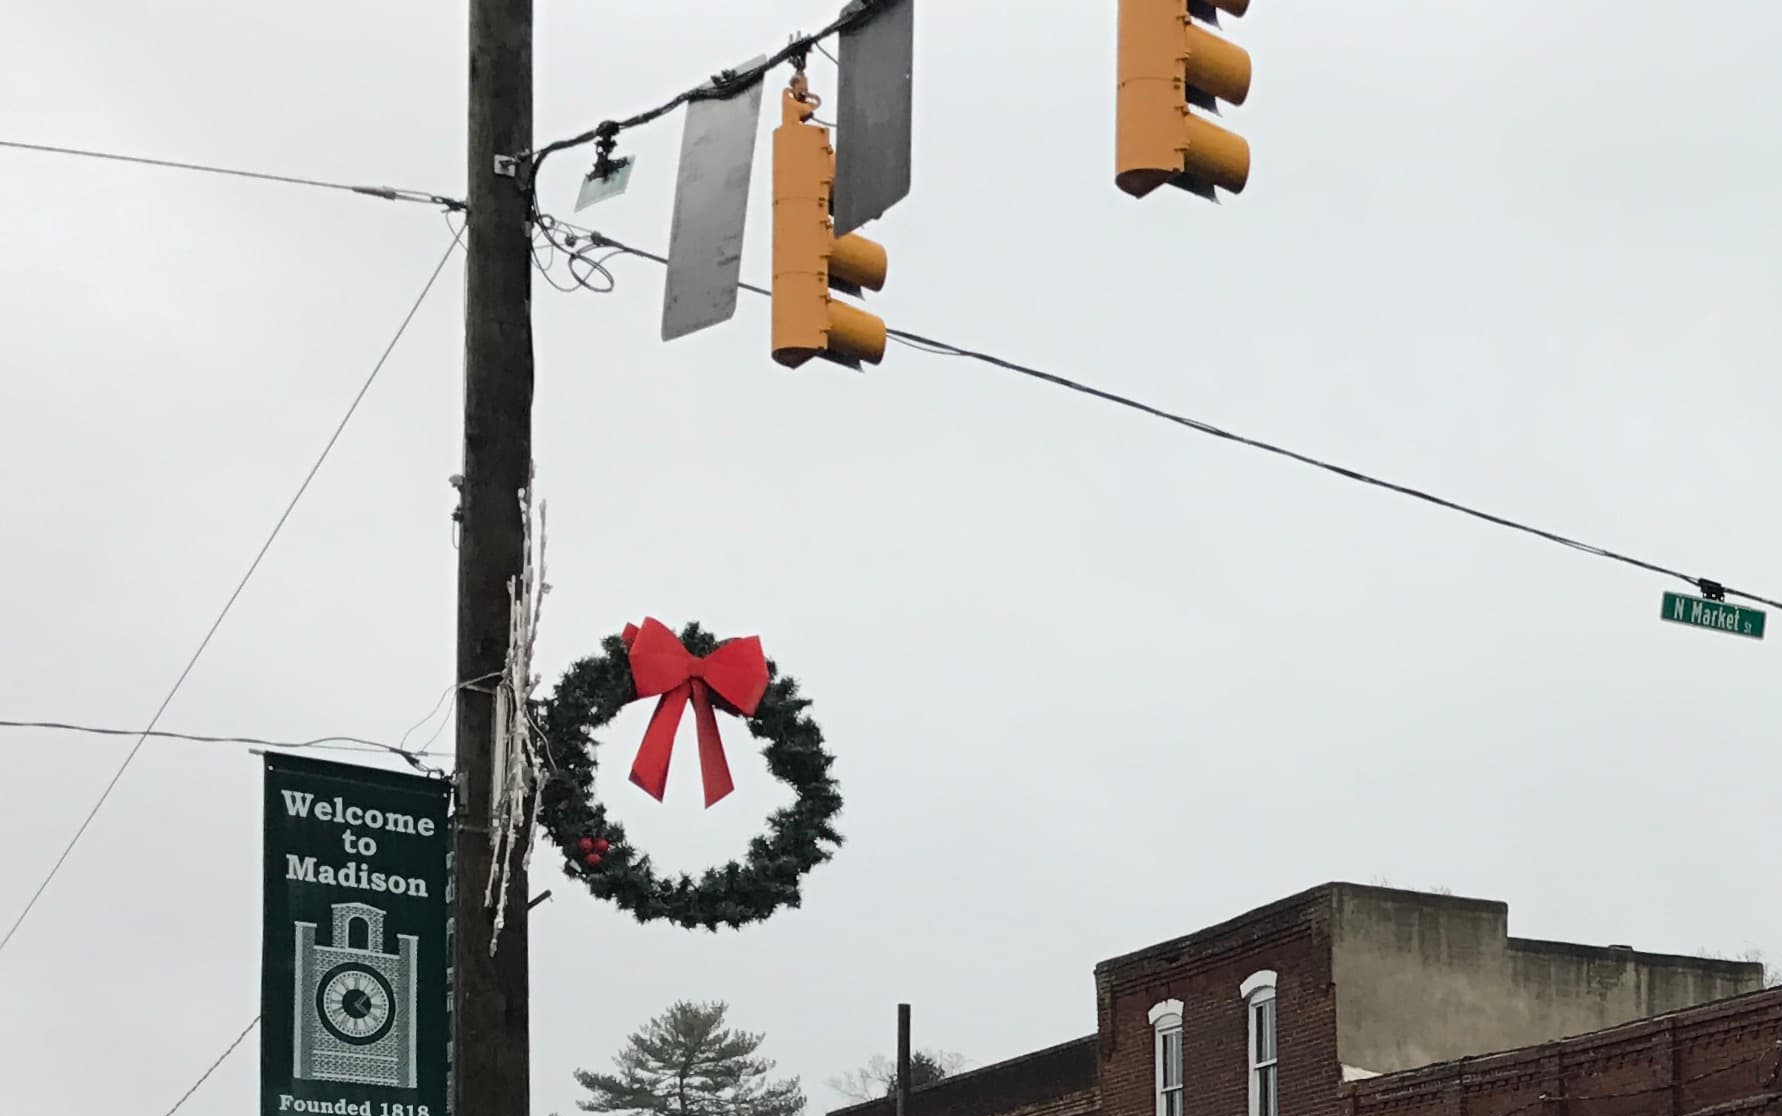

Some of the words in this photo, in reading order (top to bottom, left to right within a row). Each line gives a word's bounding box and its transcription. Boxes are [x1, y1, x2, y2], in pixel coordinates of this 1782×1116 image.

[1674, 597, 1685, 620] N
[1691, 599, 1741, 632] Market
[281, 789, 436, 837] Welcome
[342, 828, 377, 857] to
[285, 853, 429, 899] Madison
